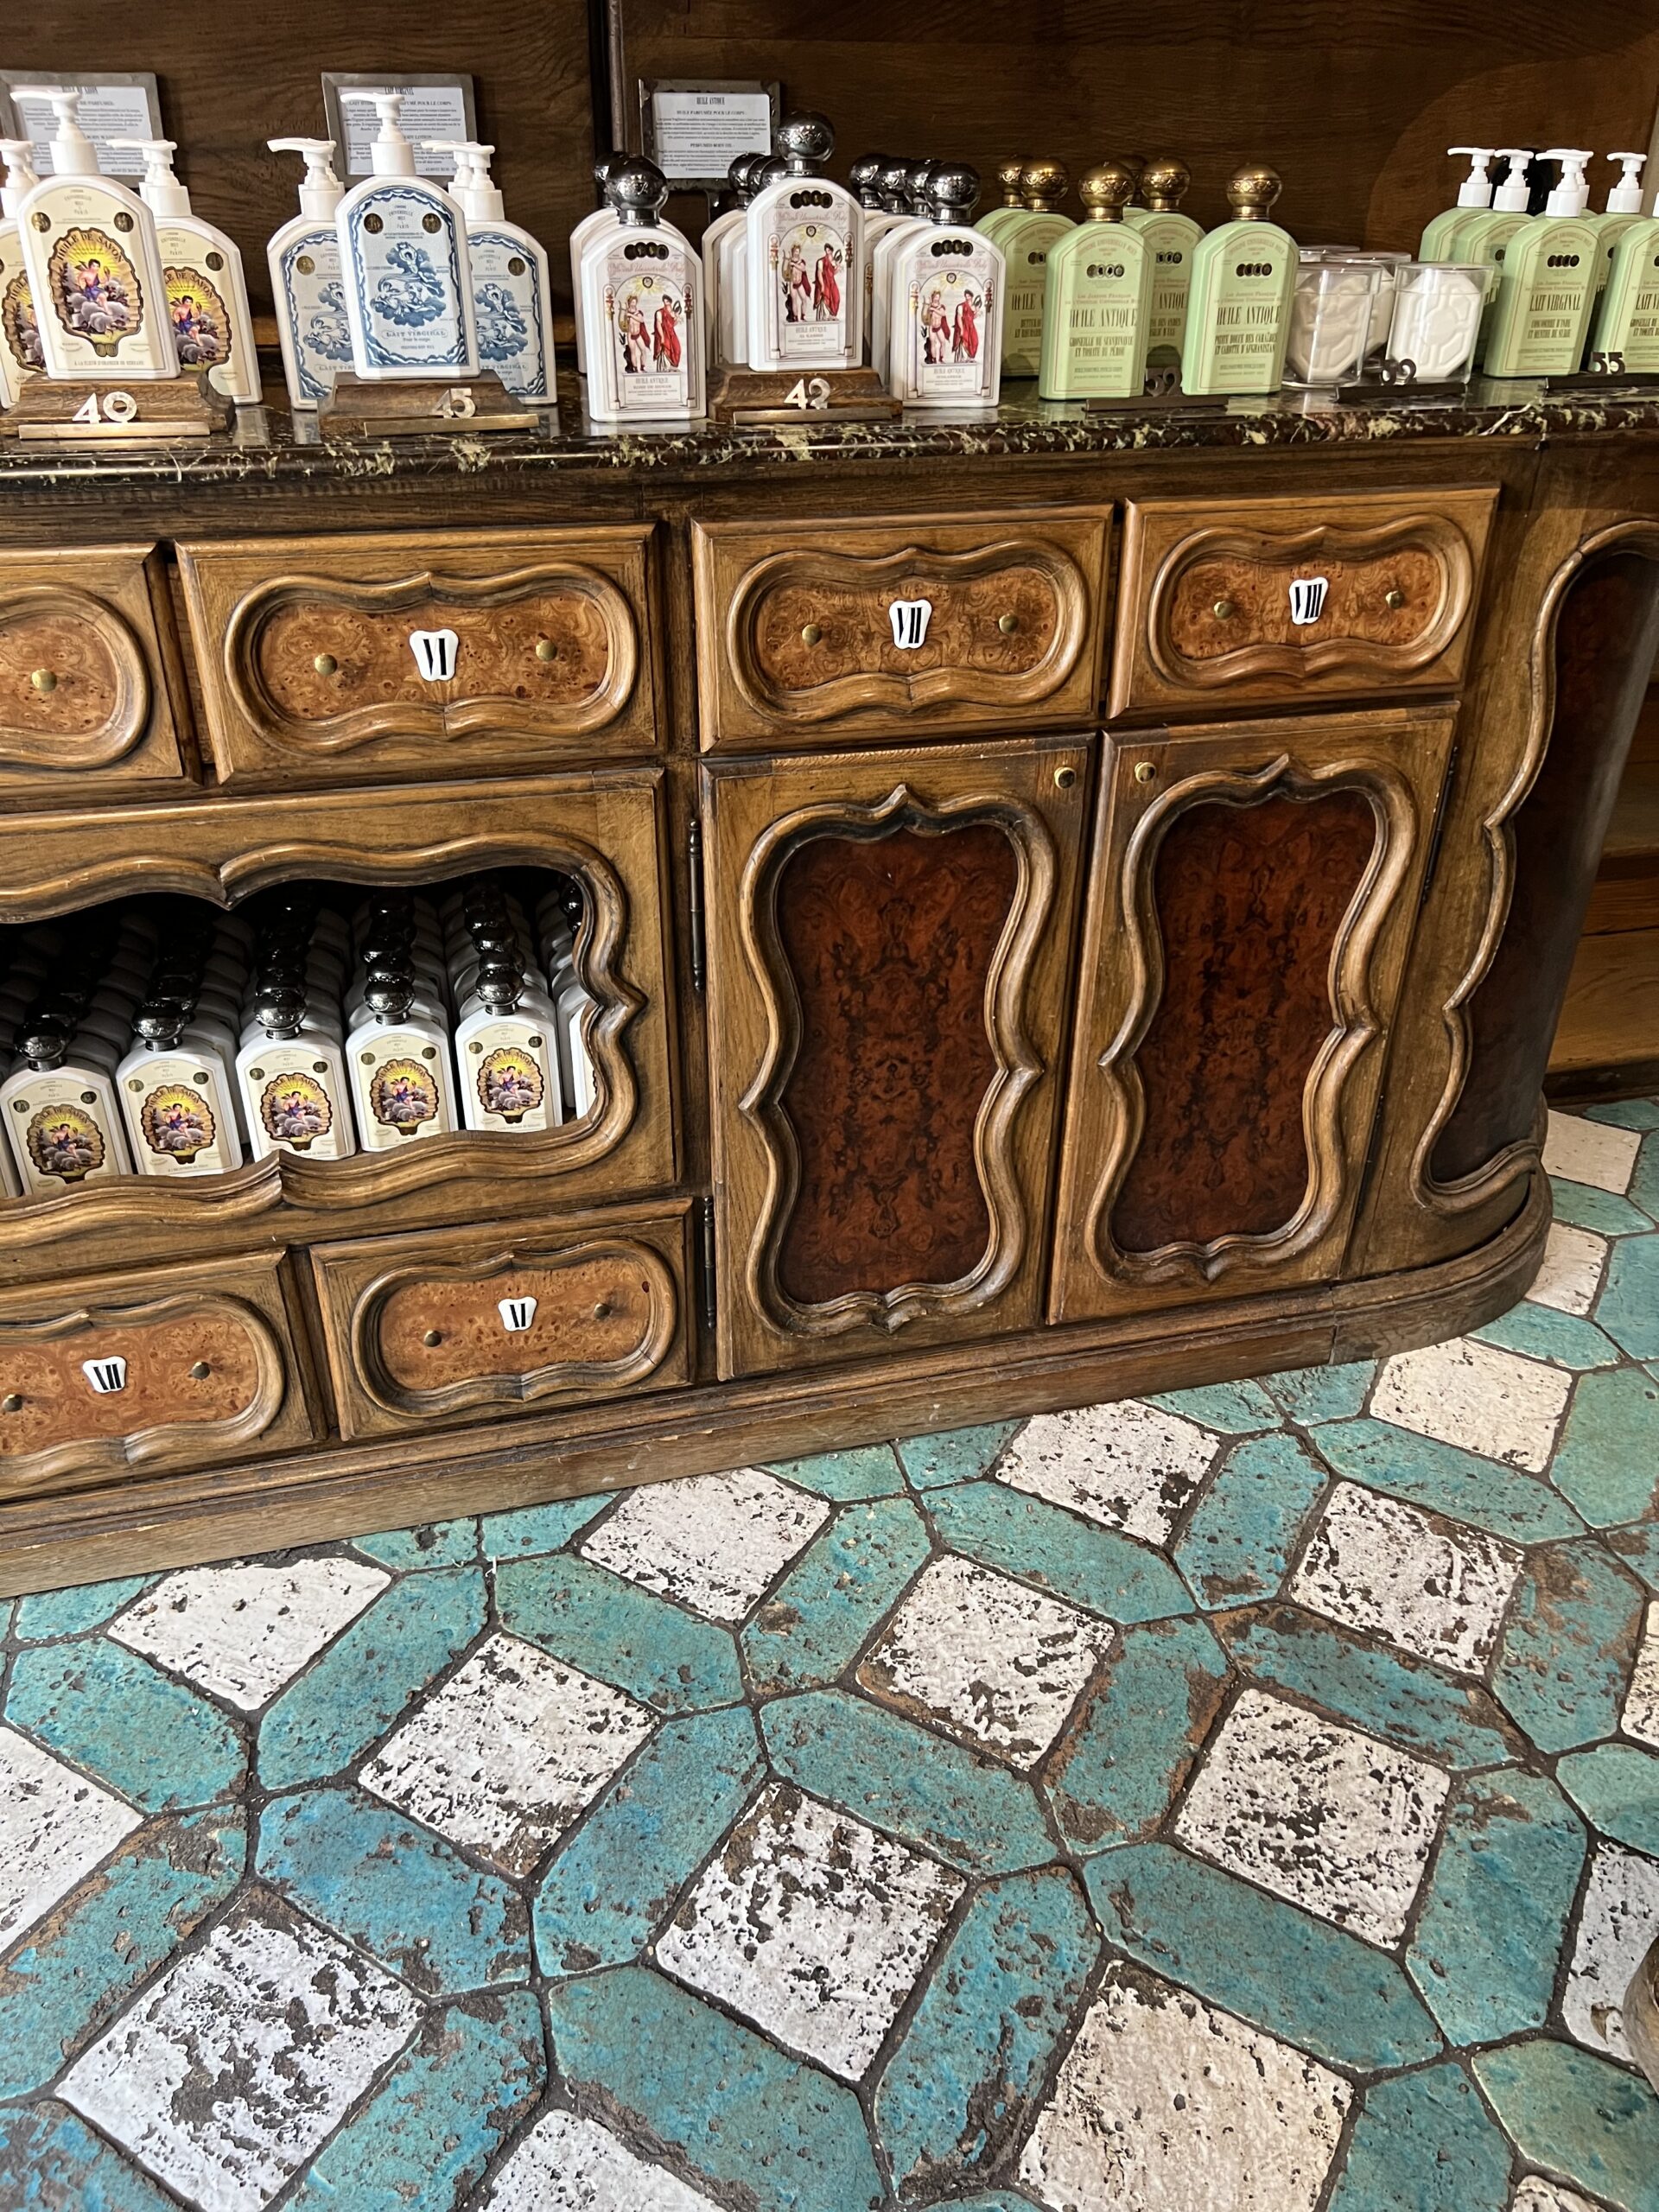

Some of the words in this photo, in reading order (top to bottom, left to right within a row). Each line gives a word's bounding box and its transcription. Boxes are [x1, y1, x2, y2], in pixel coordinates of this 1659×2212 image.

[57, 234, 79, 261] HUILE
[97, 236, 123, 263] SAVON
[191, 272, 213, 298] SAVON
[1070, 308, 1096, 327] HUILE
[1099, 308, 1138, 327] ANTIQUE
[1217, 307, 1242, 325] HUILE
[1247, 305, 1281, 325] ANTIQUE
[1529, 295, 1547, 311] LAIT
[1547, 294, 1580, 311] VIRGINAL
[72, 391, 137, 423] 40
[433, 387, 476, 418] 45
[784, 378, 830, 410] 42
[1294, 582, 1324, 620] VIII
[897, 607, 923, 645] VII
[422, 638, 448, 676] VI
